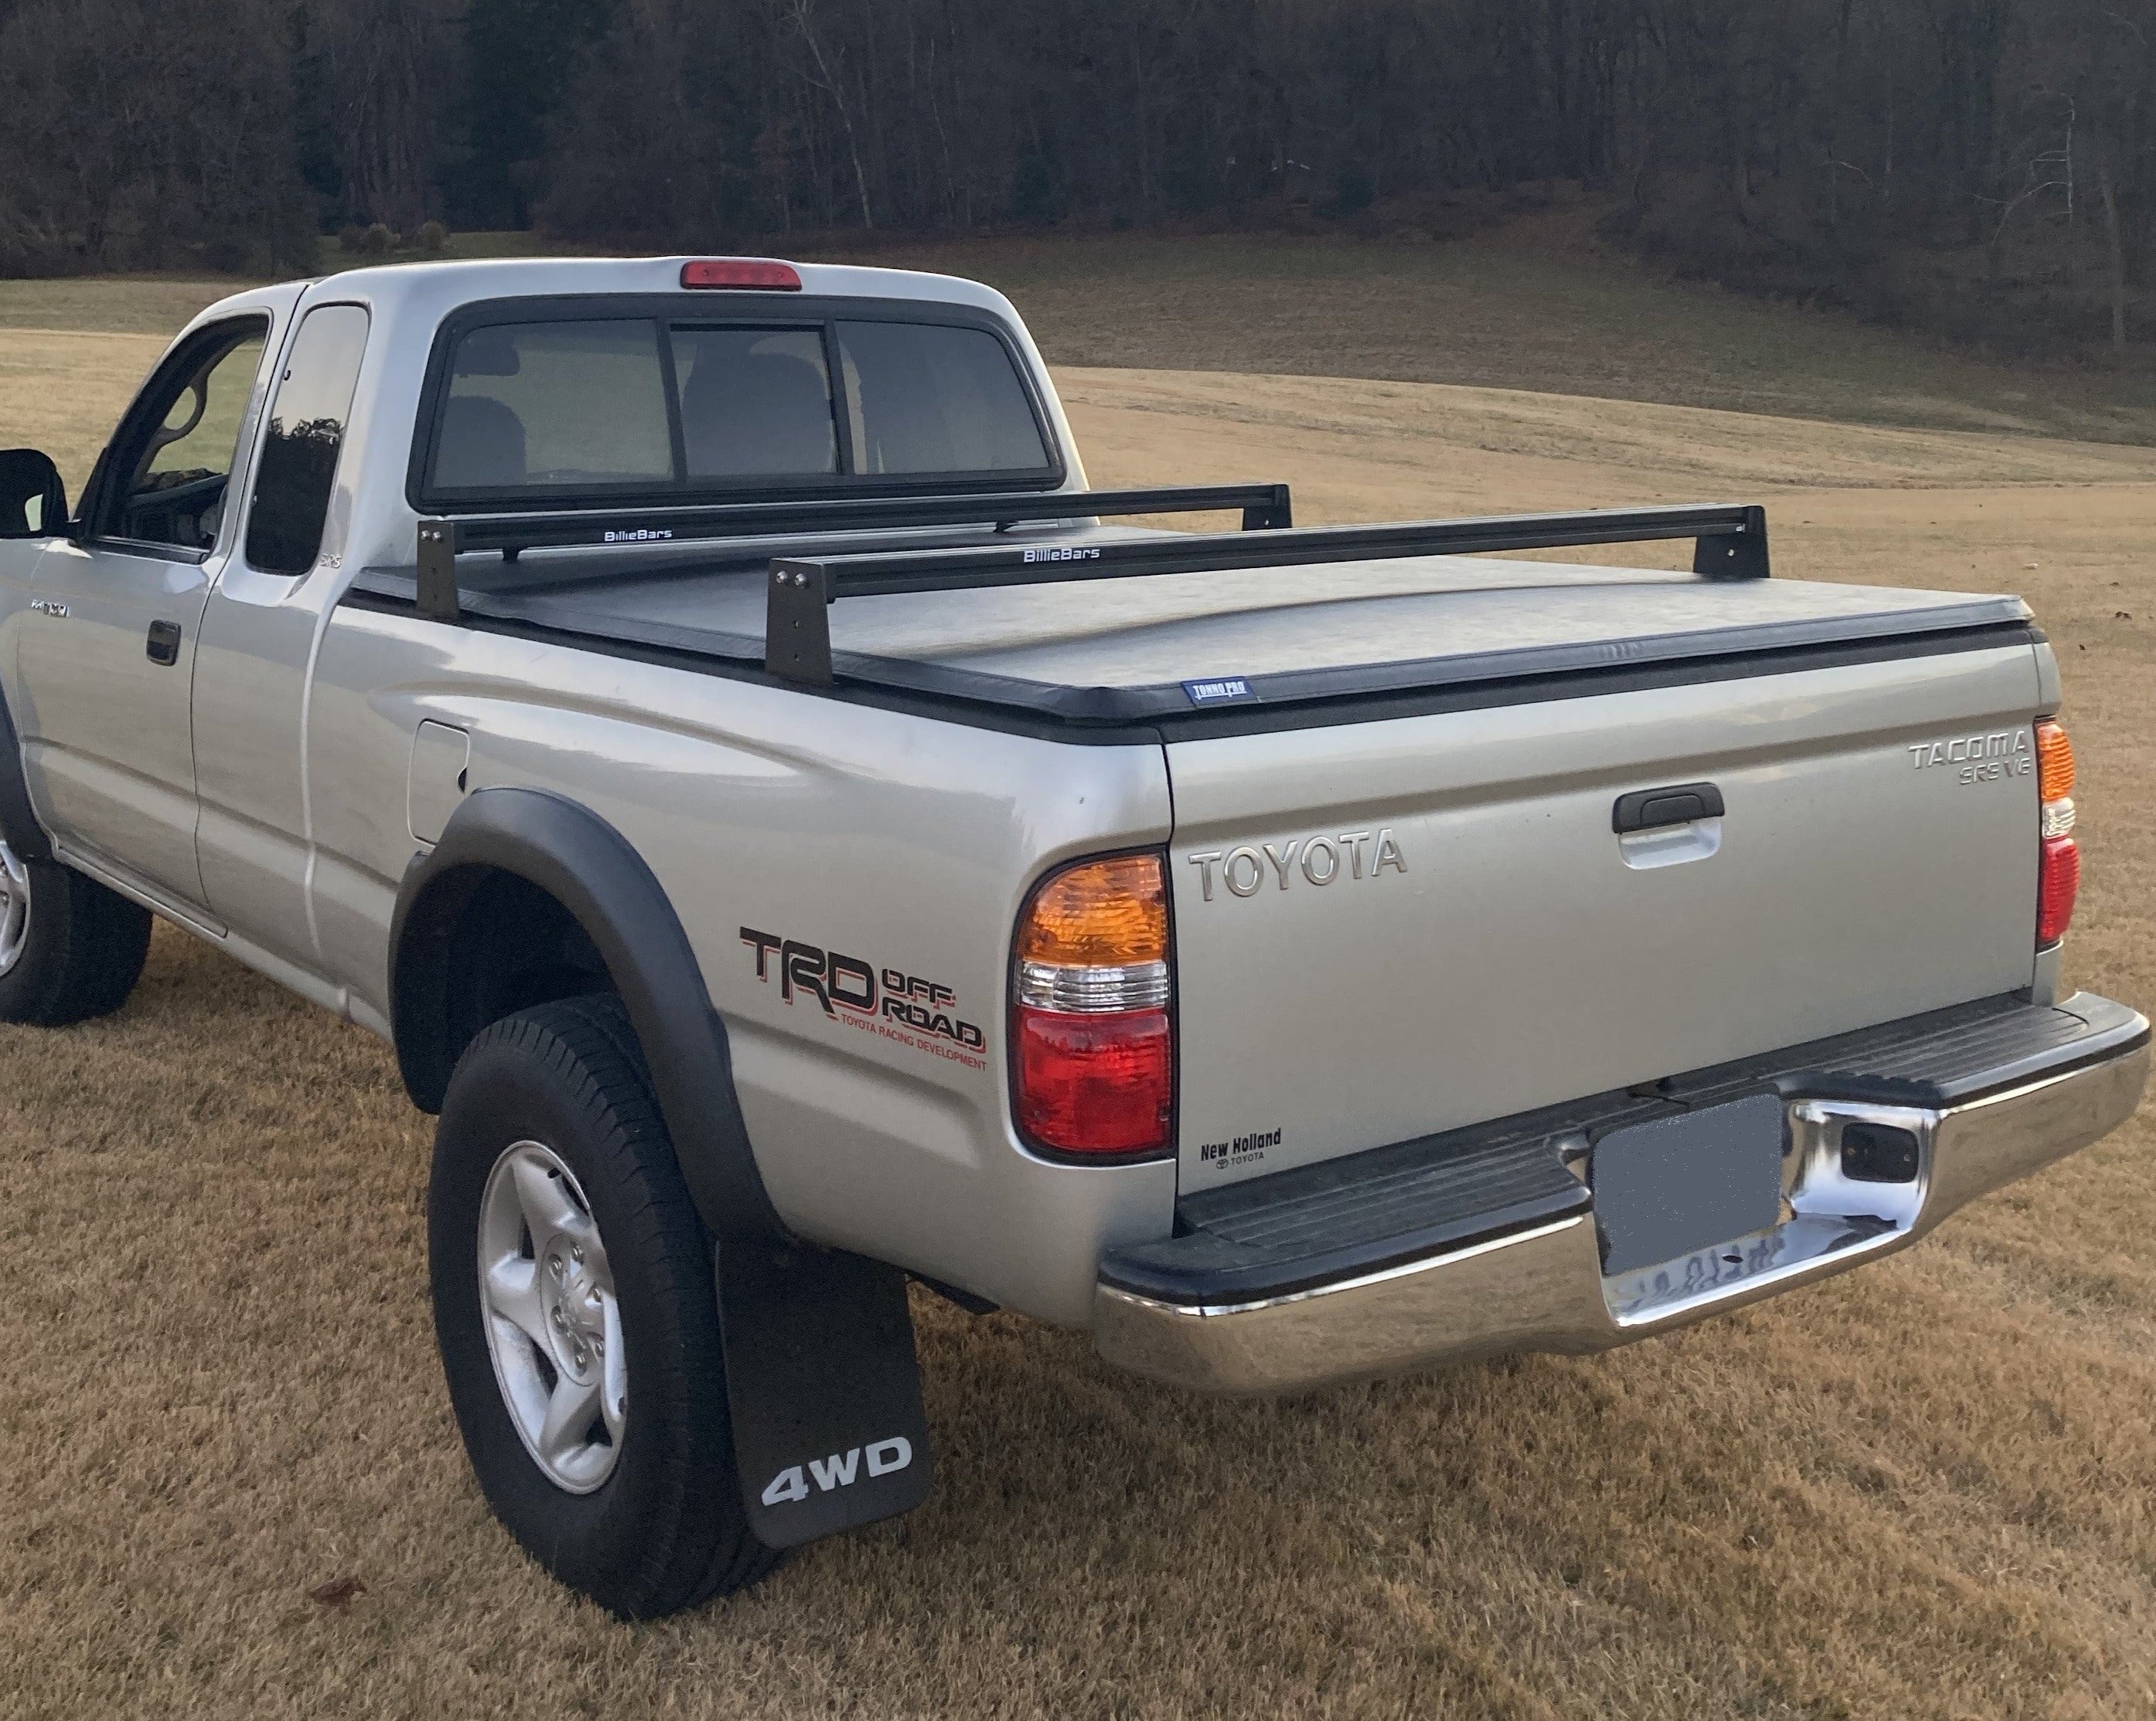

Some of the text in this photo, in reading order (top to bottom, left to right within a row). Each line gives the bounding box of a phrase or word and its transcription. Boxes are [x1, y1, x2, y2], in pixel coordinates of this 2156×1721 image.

[604, 529, 672, 541] BillieBars
[1024, 548, 1101, 563] BillieBars
[1225, 681, 1246, 697] PRO
[1908, 731, 2029, 769] TACOMA
[1189, 828, 1408, 901] TOYOTA
[740, 926, 878, 1020] TRD
[882, 968, 956, 1009] OFF
[842, 1013, 987, 1071] TOYOTA RACING DEVELOPMENT
[882, 997, 986, 1054] ROAD
[1201, 1128, 1281, 1161] New Holland
[1231, 1151, 1264, 1166] TOYOTA
[762, 1437, 913, 1506] 4WD
